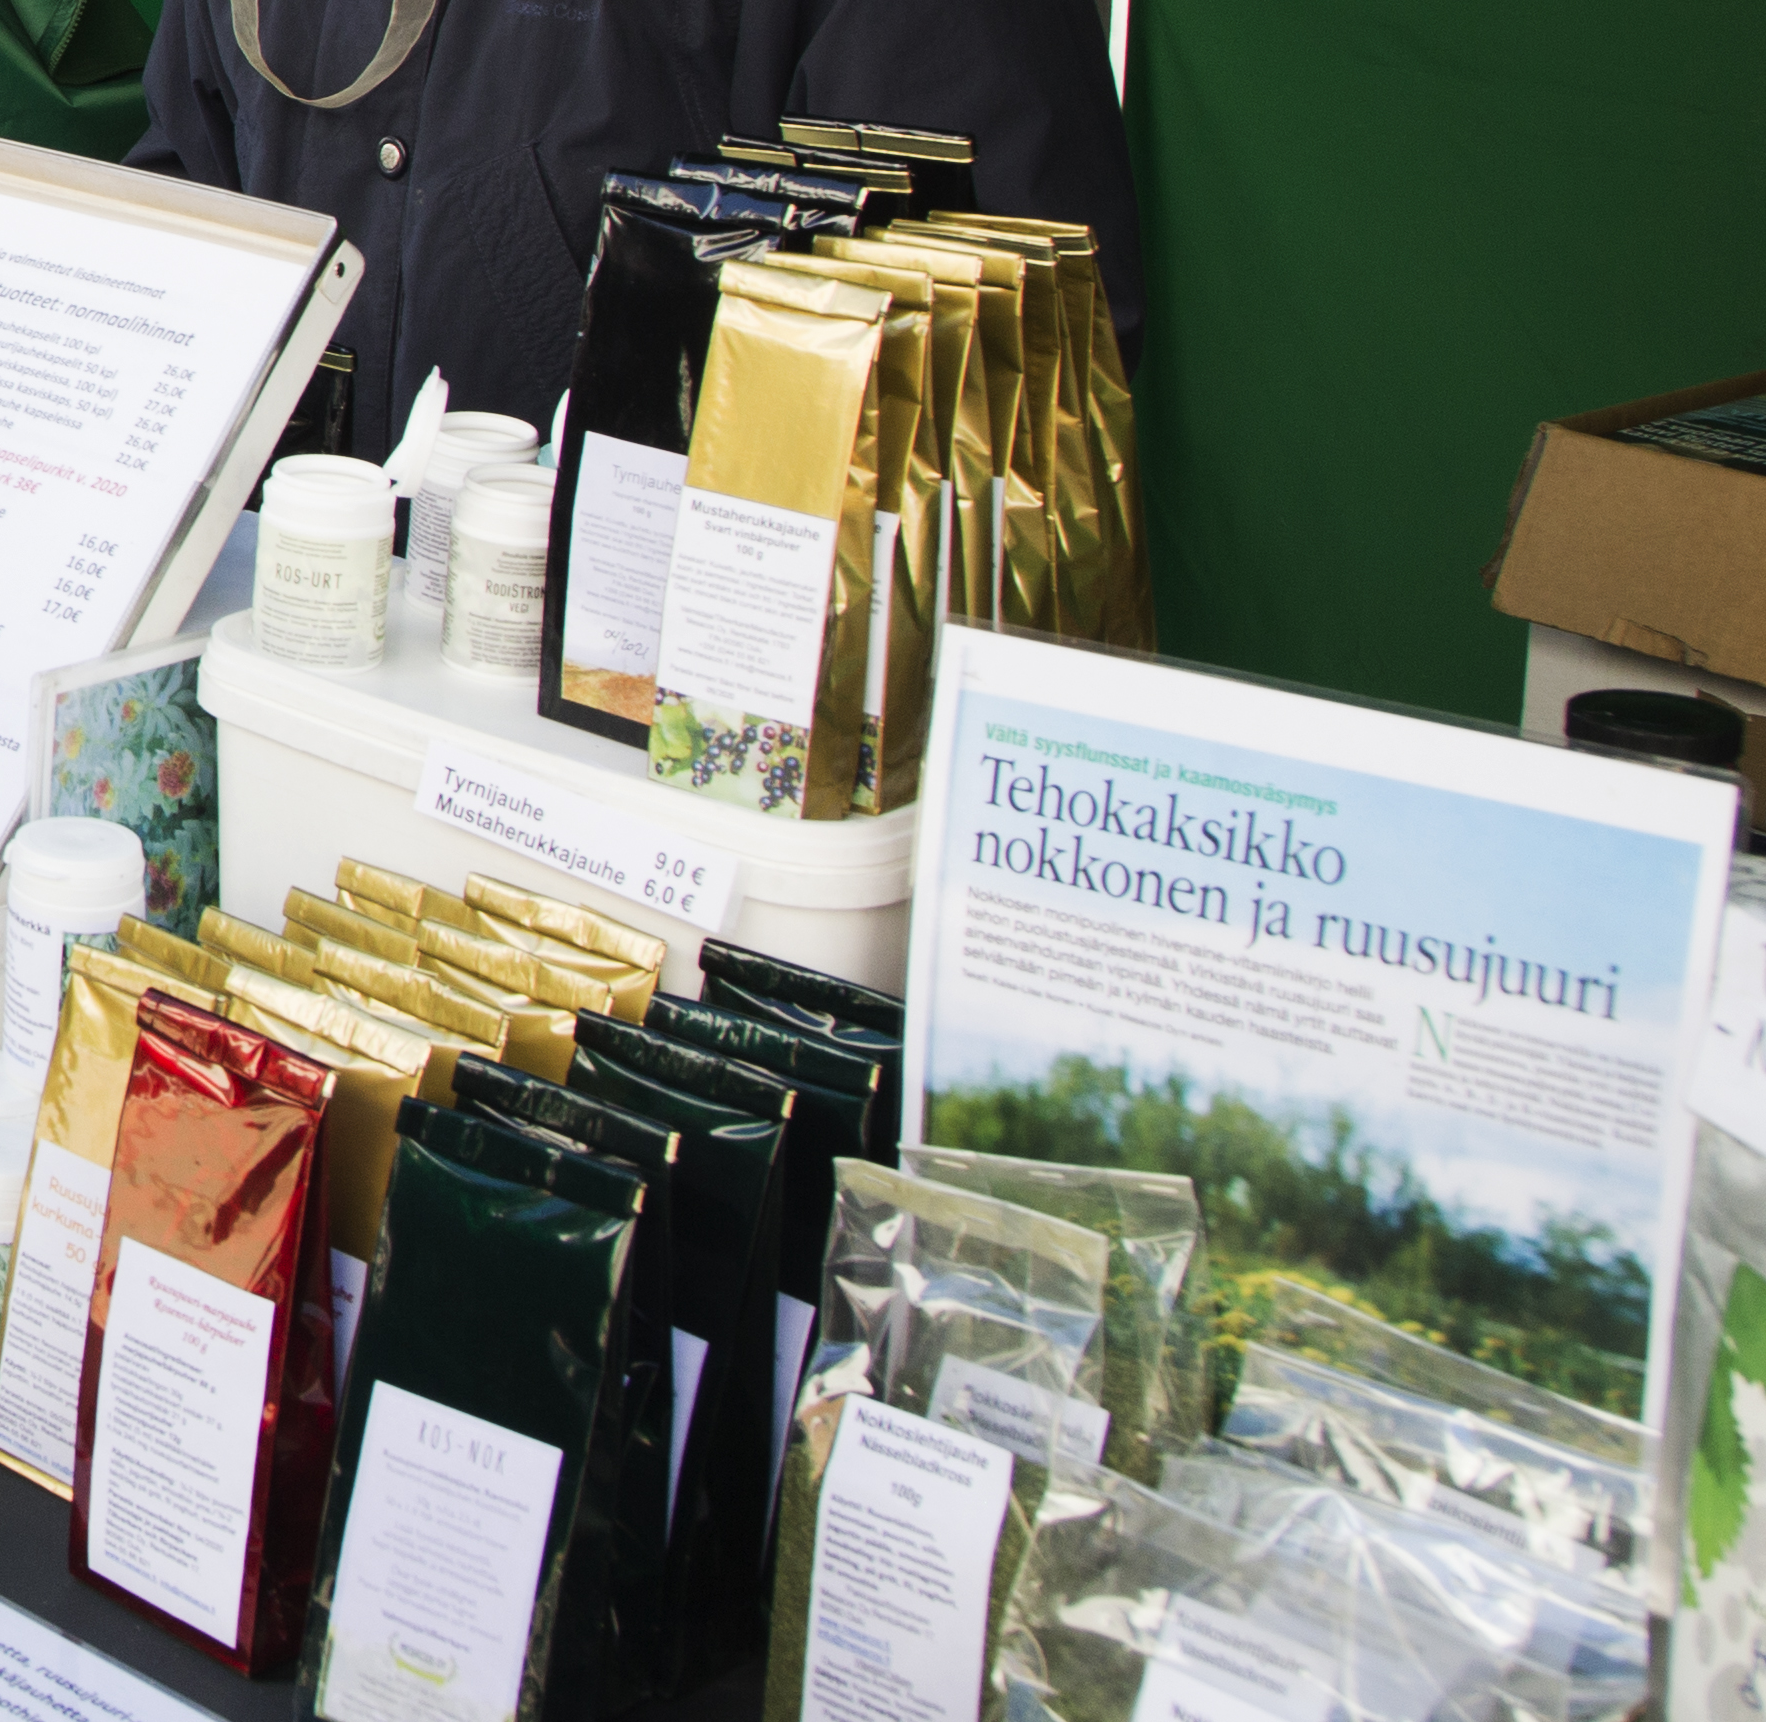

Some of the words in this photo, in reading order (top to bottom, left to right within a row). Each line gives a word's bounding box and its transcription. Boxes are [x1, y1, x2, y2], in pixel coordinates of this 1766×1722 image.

[63, 303, 196, 347] normaalihinnat
[12, 475, 42, 495] 38€
[75, 473, 90, 485] v.
[89, 475, 129, 498] 2020
[77, 532, 119, 558] 16,0€
[64, 554, 108, 580] 16,0€
[274, 561, 343, 590] ROS-URT
[52, 576, 96, 602] 16,0€
[40, 598, 84, 624] 17,0€
[985, 722, 1030, 748] Vältä
[1033, 735, 1151, 775] syysflunssat
[1152, 762, 1173, 781] ja
[1176, 763, 1338, 817] kaamosväsymys
[443, 765, 545, 823] Tyrnijauhe
[653, 850, 687, 879] 9,0
[689, 865, 707, 887] €
[980, 753, 1348, 886] Tehokaksikko
[434, 791, 626, 886] Mustaherukkajauhe
[642, 877, 676, 906] 6,0
[679, 892, 696, 914] €
[972, 824, 1231, 926] nokkonen
[1250, 878, 1293, 944] ja
[1313, 910, 1624, 1022] ruusujuuri
